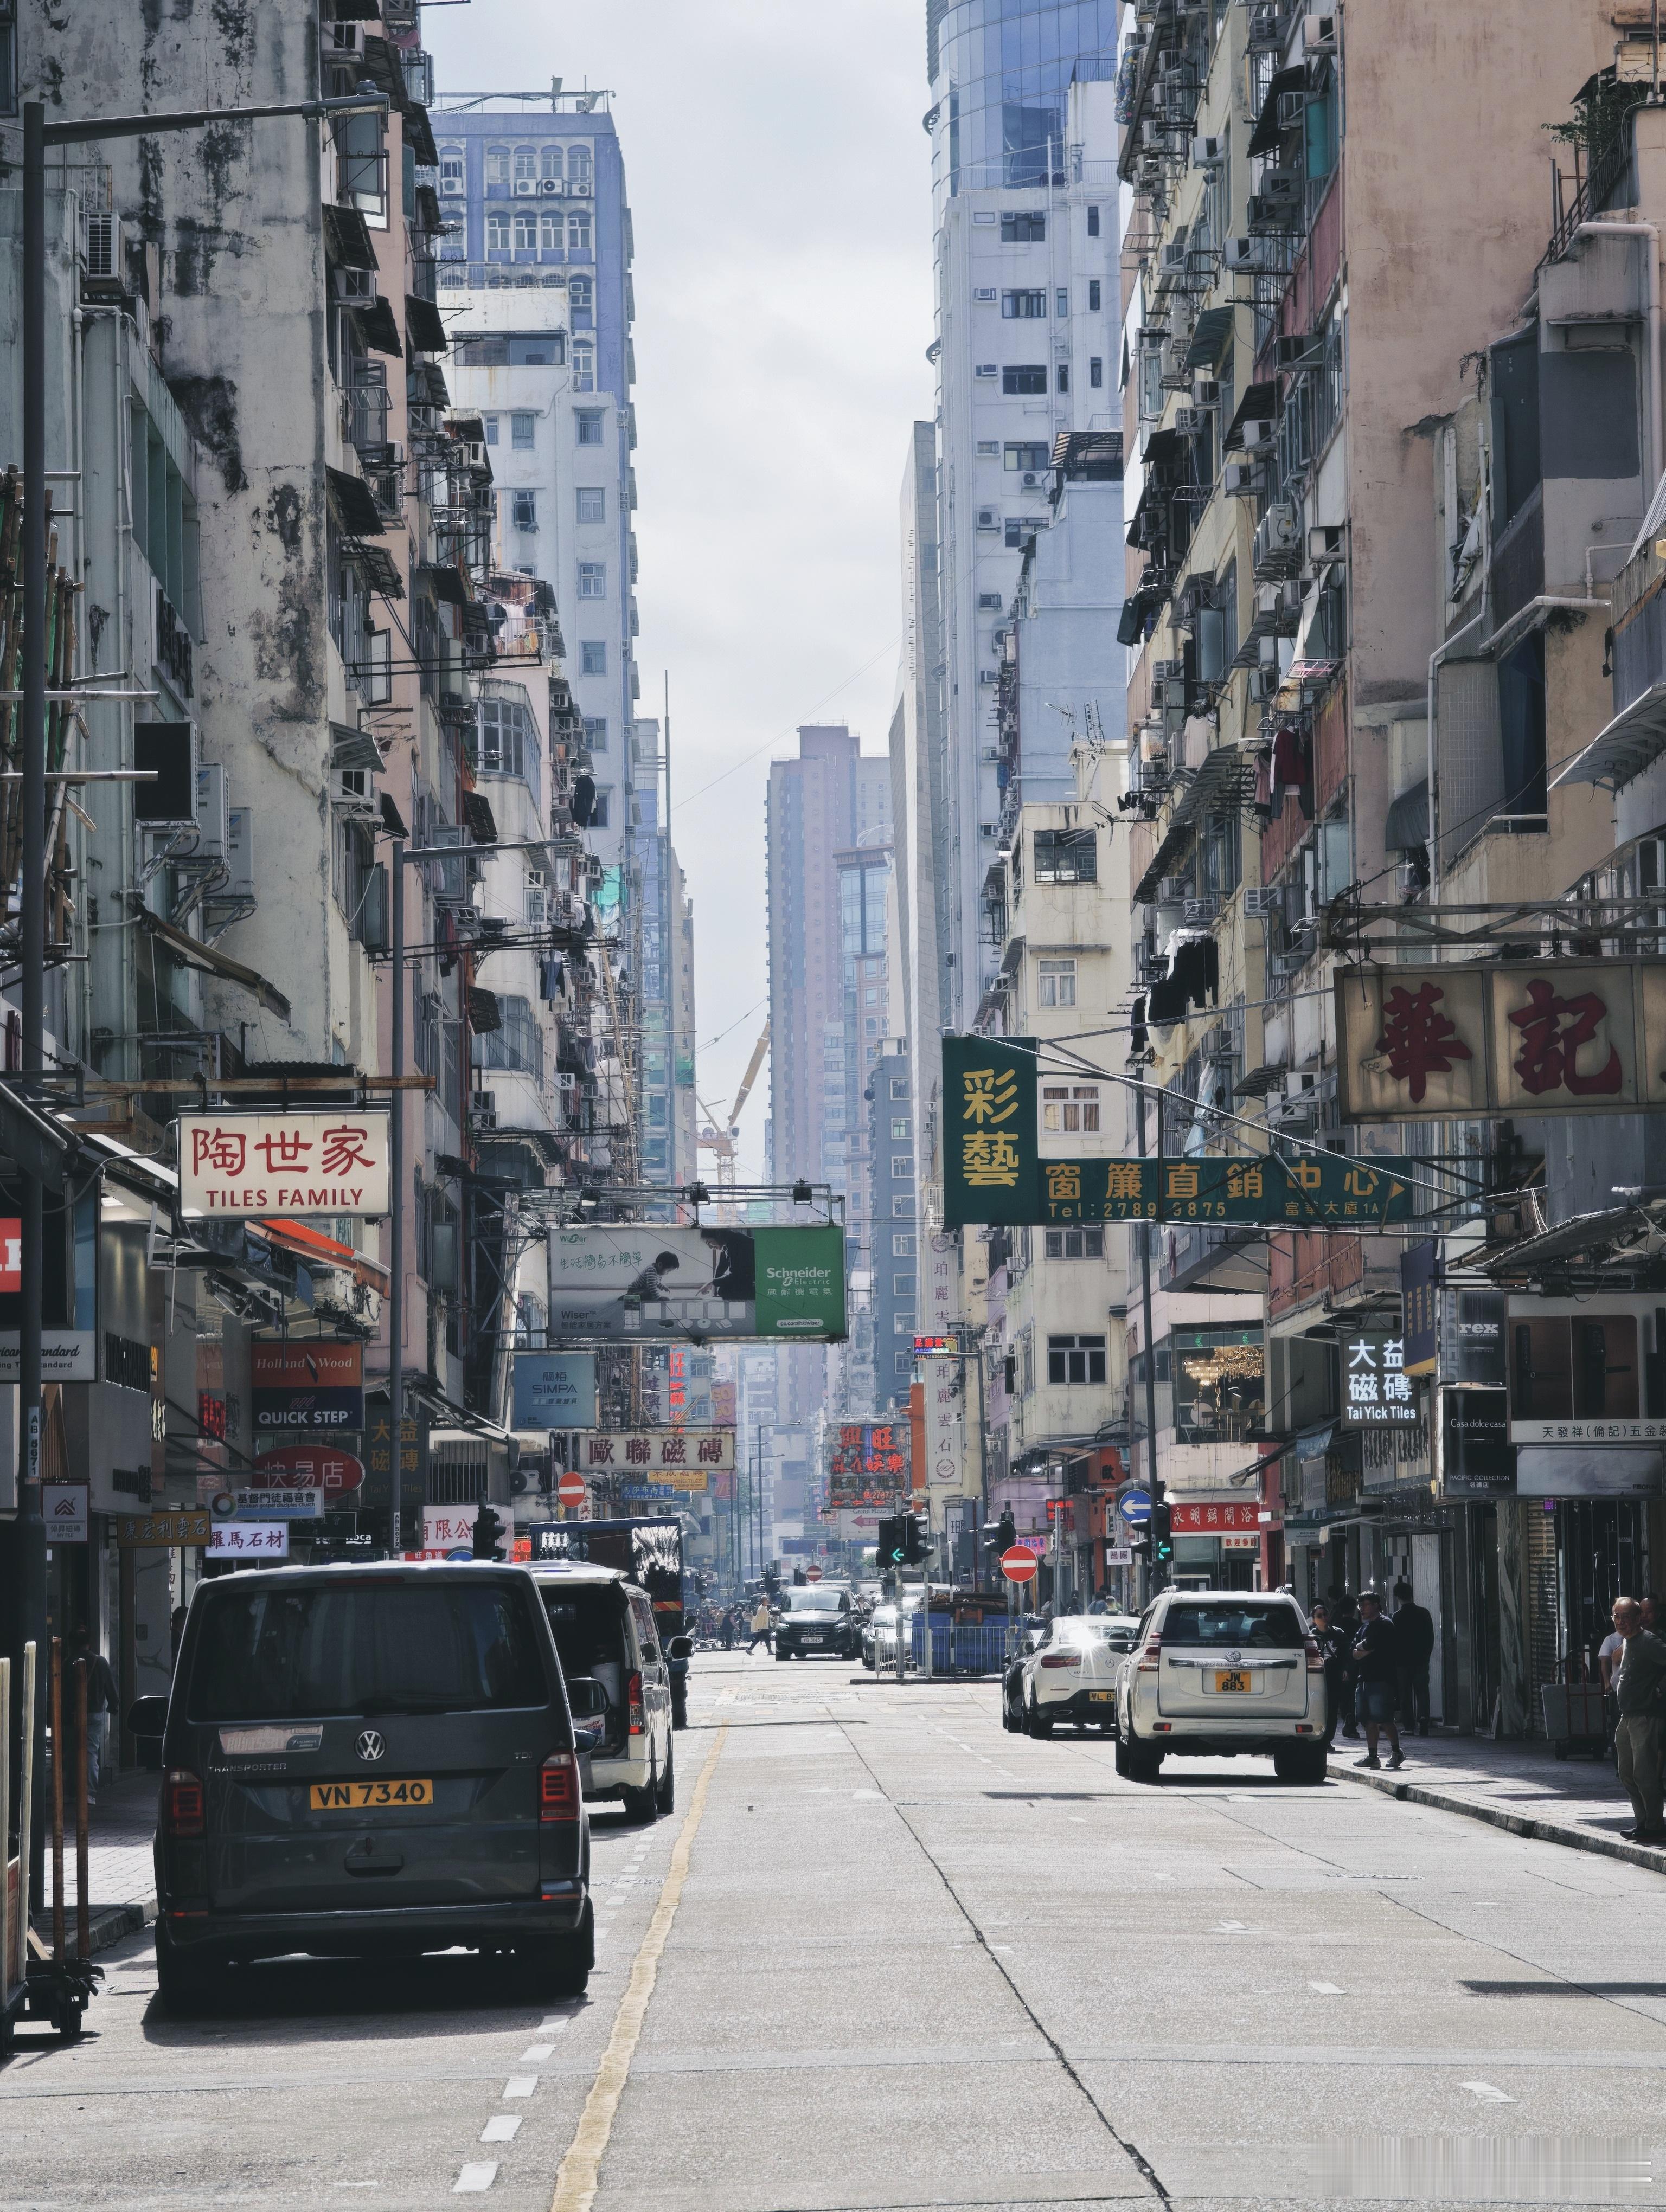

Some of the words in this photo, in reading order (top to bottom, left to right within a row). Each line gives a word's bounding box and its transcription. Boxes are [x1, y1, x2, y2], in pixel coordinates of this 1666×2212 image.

[1375, 979, 1666, 1103] 華記
[963, 1068, 1020, 1186] 彩藝
[192, 1124, 375, 1176] 陶世家
[206, 1190, 268, 1207] TILES
[277, 1188, 363, 1206] FAMILY
[560, 1251, 643, 1270] 生活簡易不簡單
[767, 1267, 831, 1278] Schneider
[767, 1288, 832, 1296] 施耐德電氣
[561, 1321, 612, 1329] 智能家居方案
[1459, 1323, 1498, 1334] rex
[1348, 1339, 1402, 1368] 大益
[257, 1358, 304, 1368] Holland
[318, 1358, 352, 1367] Wood
[532, 1384, 578, 1394] SIMPA
[1348, 1372, 1412, 1401] 磁磚
[258, 1412, 307, 1424] QUICK
[314, 1411, 348, 1423] STEP
[1346, 1406, 1362, 1419] Tai
[1364, 1406, 1388, 1419] Yick
[1390, 1406, 1416, 1419] Tiles
[1451, 1418, 1468, 1427] Casa
[1470, 1419, 1489, 1427] dolce
[588, 1438, 724, 1465] 歐聯磁磚
[265, 1461, 344, 1488] 快易店
[238, 1492, 315, 1504] 基督門徒福音會
[210, 1531, 284, 1549] 羅馬石材
[1226, 1673, 1241, 1682] JW
[1222, 1682, 1245, 1691] 883
[317, 1787, 350, 1806] VN
[361, 1783, 426, 1804] 7340
